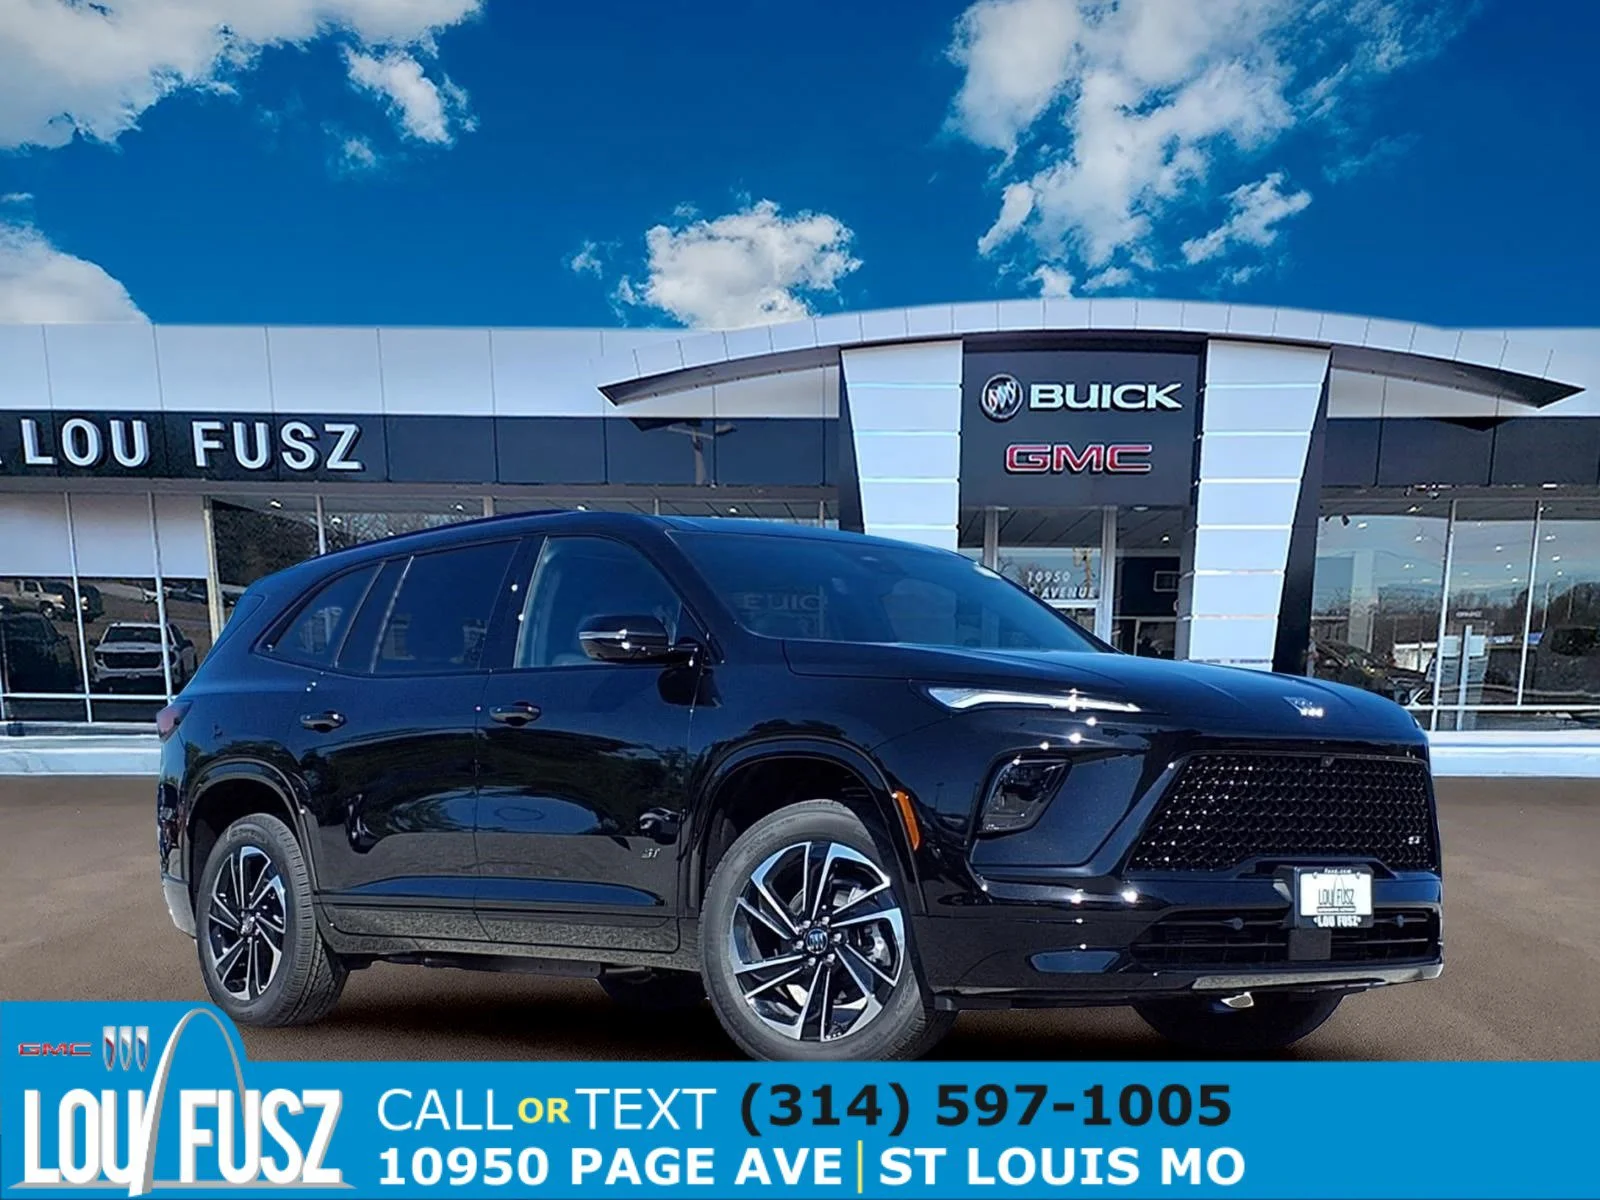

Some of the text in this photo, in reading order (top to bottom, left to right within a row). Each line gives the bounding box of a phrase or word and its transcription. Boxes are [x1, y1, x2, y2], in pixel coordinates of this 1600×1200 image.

[1029, 383, 1183, 411] BUICK
[20, 418, 364, 471] LOU FUSZ
[1005, 443, 1152, 473] GMC
[1026, 571, 1071, 583] 10950
[1041, 586, 1096, 599] AVENUE
[1318, 888, 1354, 905] LOU FUSZ
